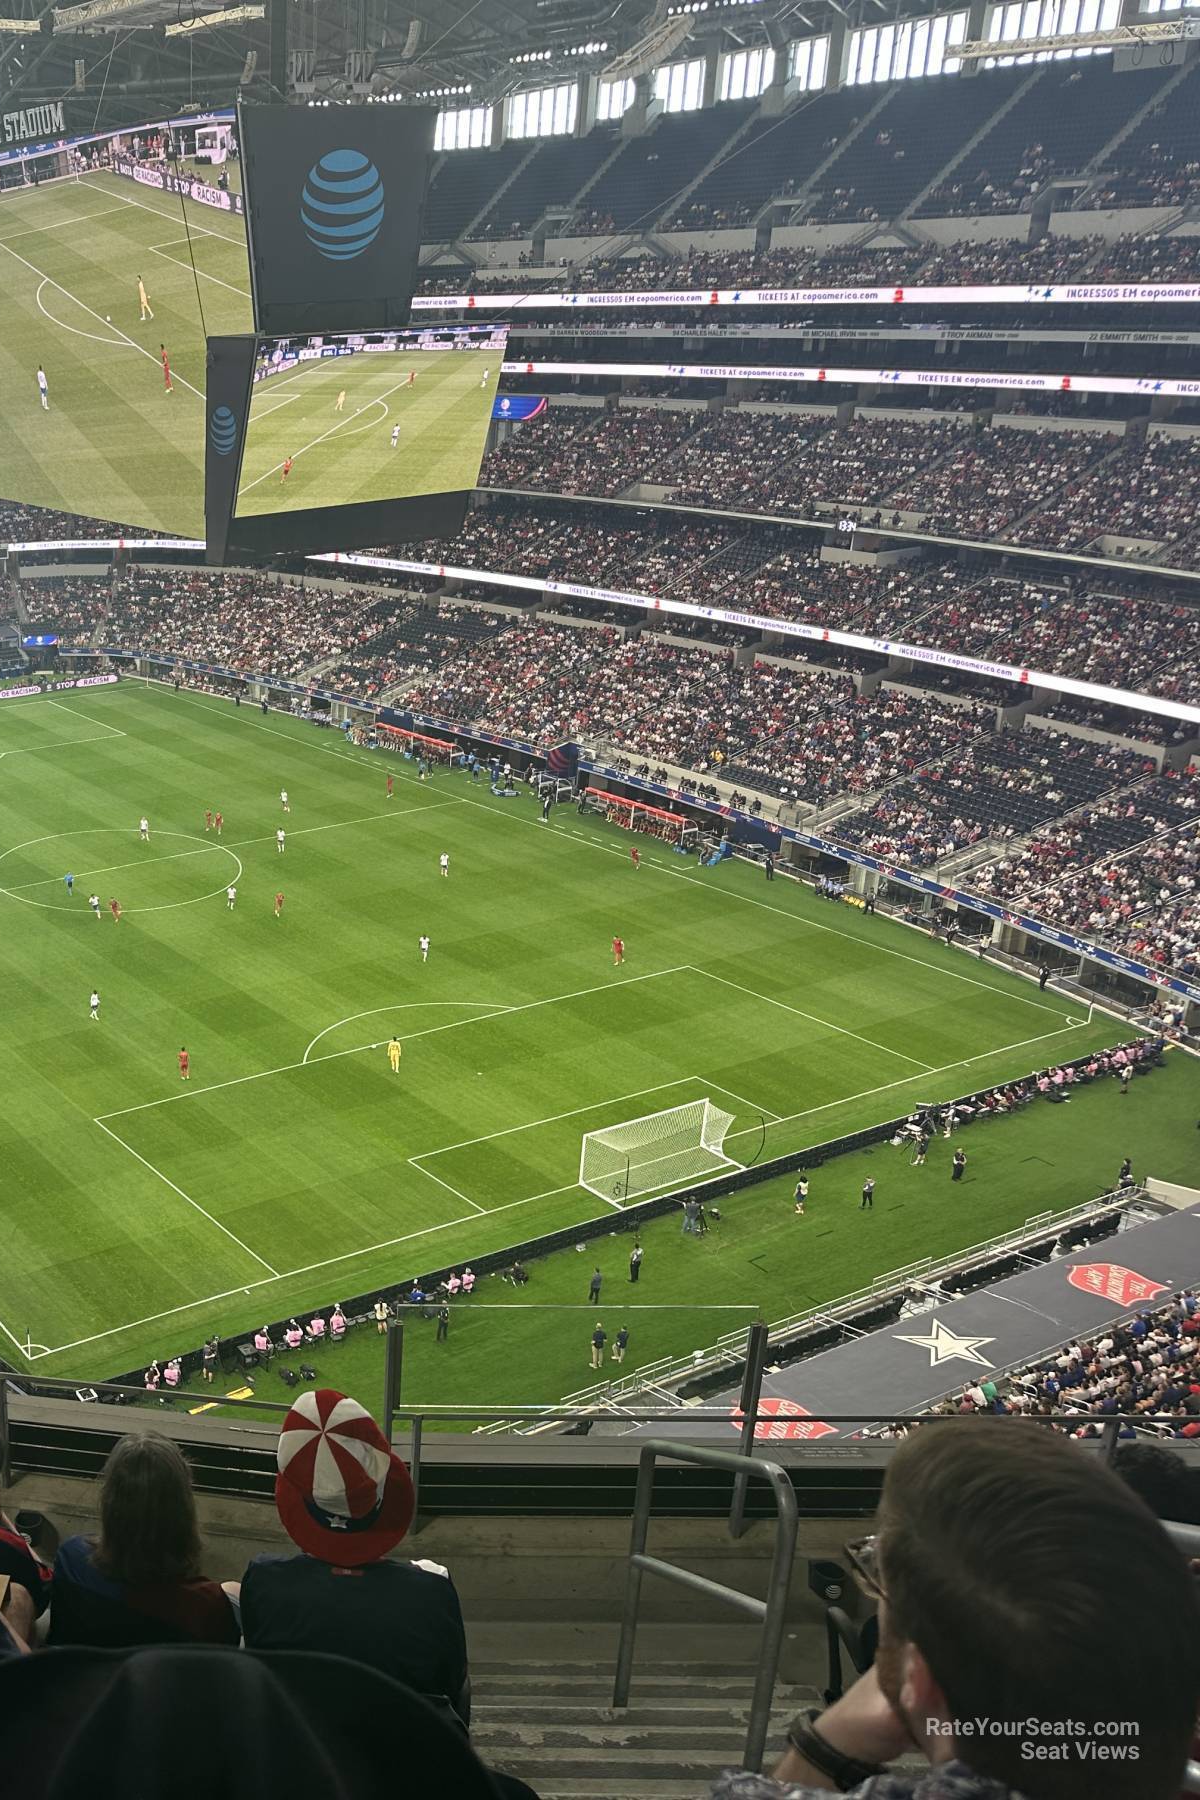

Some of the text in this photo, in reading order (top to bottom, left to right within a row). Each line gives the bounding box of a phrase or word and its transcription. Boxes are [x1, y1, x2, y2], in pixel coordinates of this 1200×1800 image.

[4, 101, 65, 142] STADIUM
[120, 163, 132, 176] BASTA
[174, 179, 190, 194] STOP
[197, 186, 222, 204] RACISM
[758, 293, 789, 302] TICKETS
[790, 292, 800, 301] AT
[1067, 289, 1120, 298] INGRESSOS
[1122, 288, 1137, 298] EM
[587, 295, 623, 303] INGRESSOS
[1100, 333, 1133, 341] EMMITT
[1133, 333, 1159, 341] SMITH
[700, 368, 727, 376] TICKETS
[917, 374, 949, 383] TICKETS
[724, 613, 747, 623] TICKETS
[899, 647, 934, 660] INGRESSOS
[936, 654, 946, 662] EM
[11, 687, 39, 696] RACISMO
[56, 681, 75, 690] STOP
[83, 676, 109, 686] RACISM
[1105, 1265, 1128, 1302] SALVATION
[1128, 1279, 1148, 1297] THE
